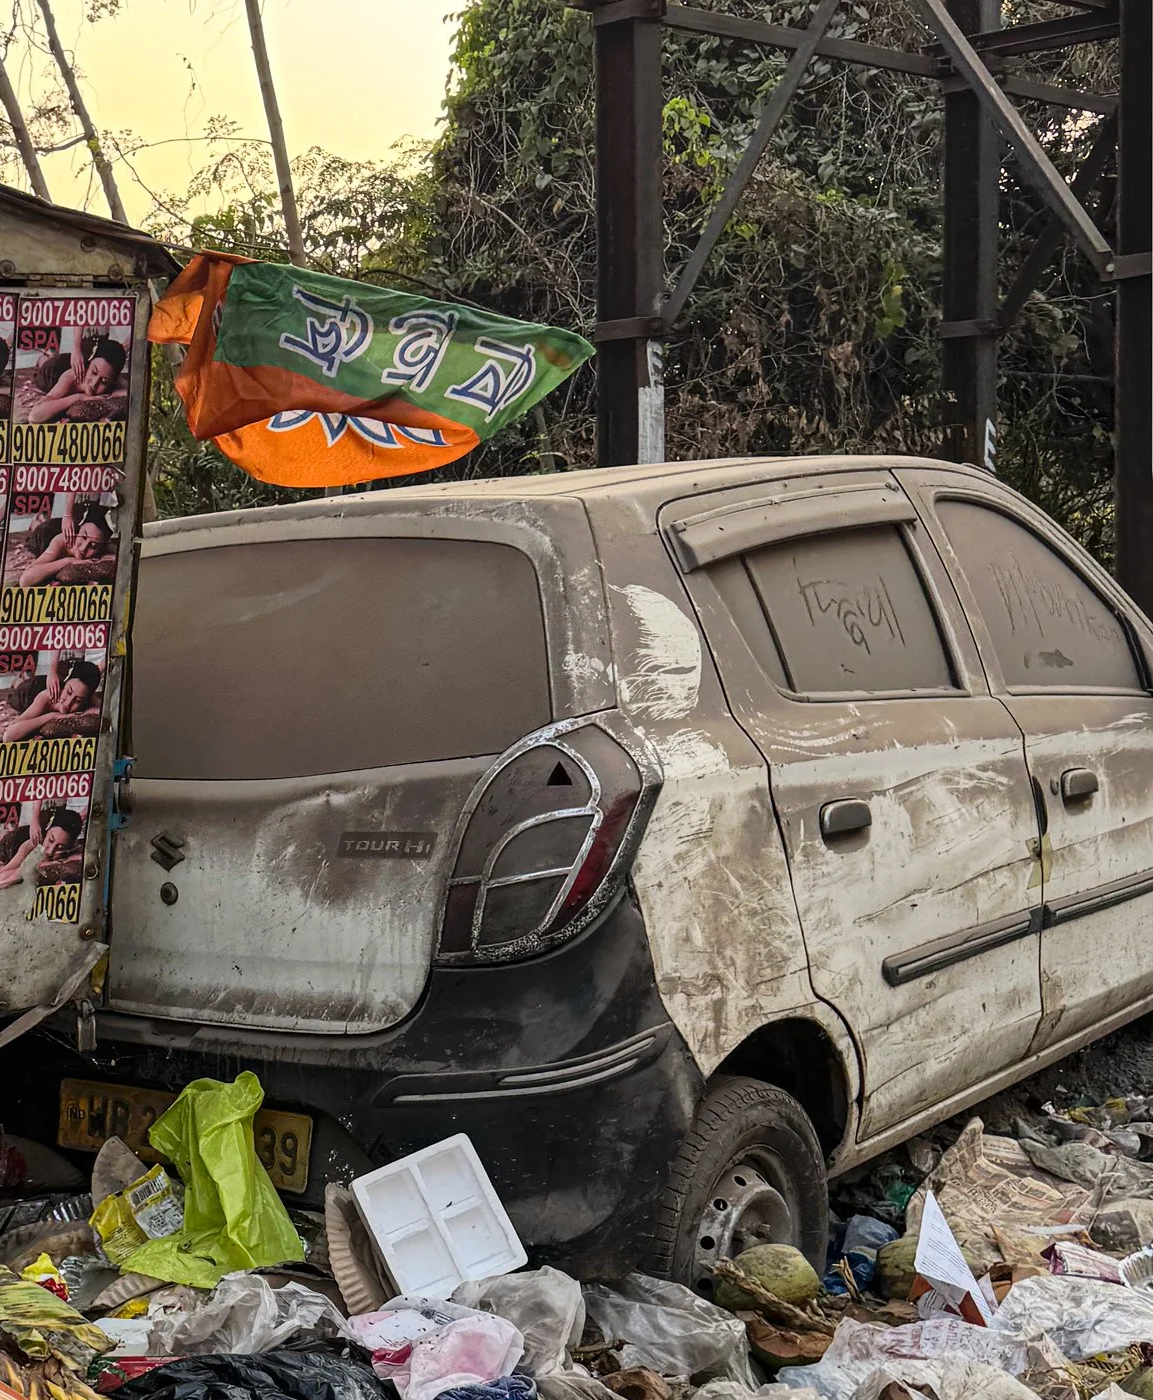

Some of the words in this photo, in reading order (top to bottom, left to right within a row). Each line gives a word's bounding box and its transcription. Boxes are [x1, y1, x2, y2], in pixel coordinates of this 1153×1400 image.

[21, 300, 130, 326] 9007480066
[19, 329, 60, 351] SPA
[14, 423, 124, 463] 9007480066
[14, 495, 52, 516] SPA
[1, 585, 110, 623] 9007480066
[343, 840, 400, 851] TOUR
